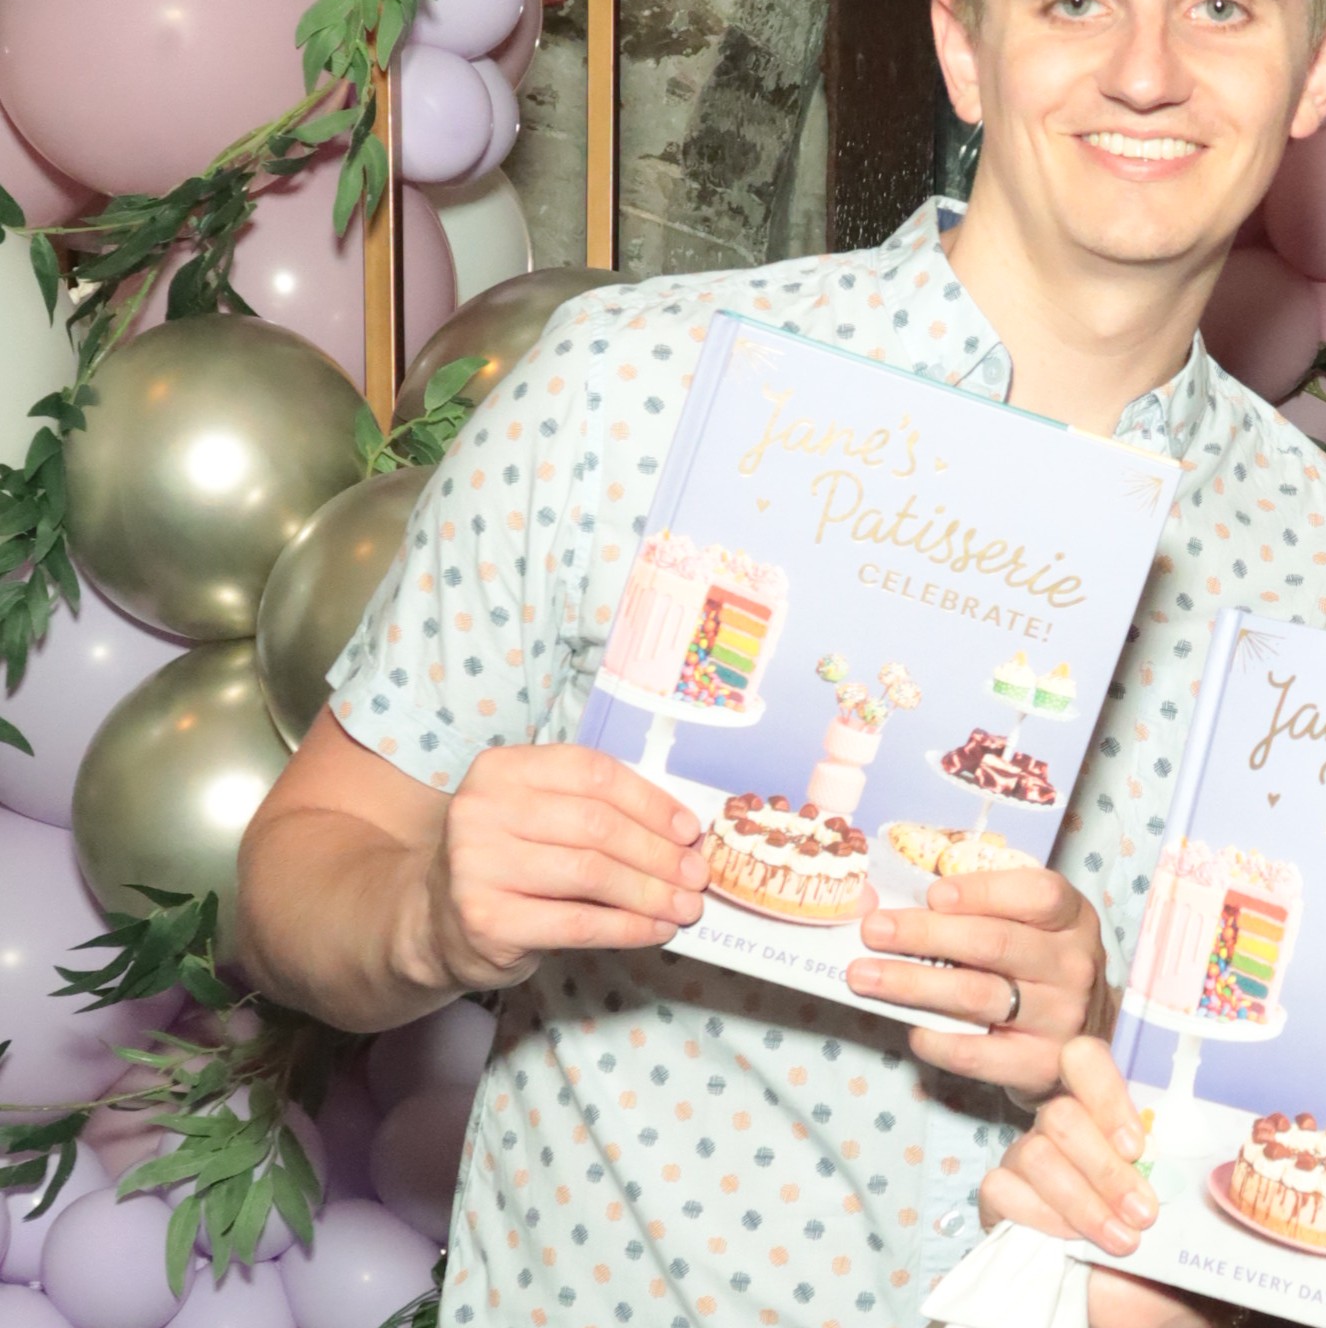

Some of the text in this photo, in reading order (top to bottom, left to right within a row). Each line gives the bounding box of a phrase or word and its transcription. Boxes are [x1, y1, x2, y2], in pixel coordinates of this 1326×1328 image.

[738, 380, 920, 478] Jane's
[810, 469, 1087, 609] Patisserie
[857, 562, 1053, 644] CELEBRATE!
[697, 926, 757, 955] EVERY
[762, 946, 798, 968] DAY
[803, 958, 848, 984] SPEC
[1177, 1249, 1226, 1276] BAKE
[1233, 1265, 1292, 1295] EVERY
